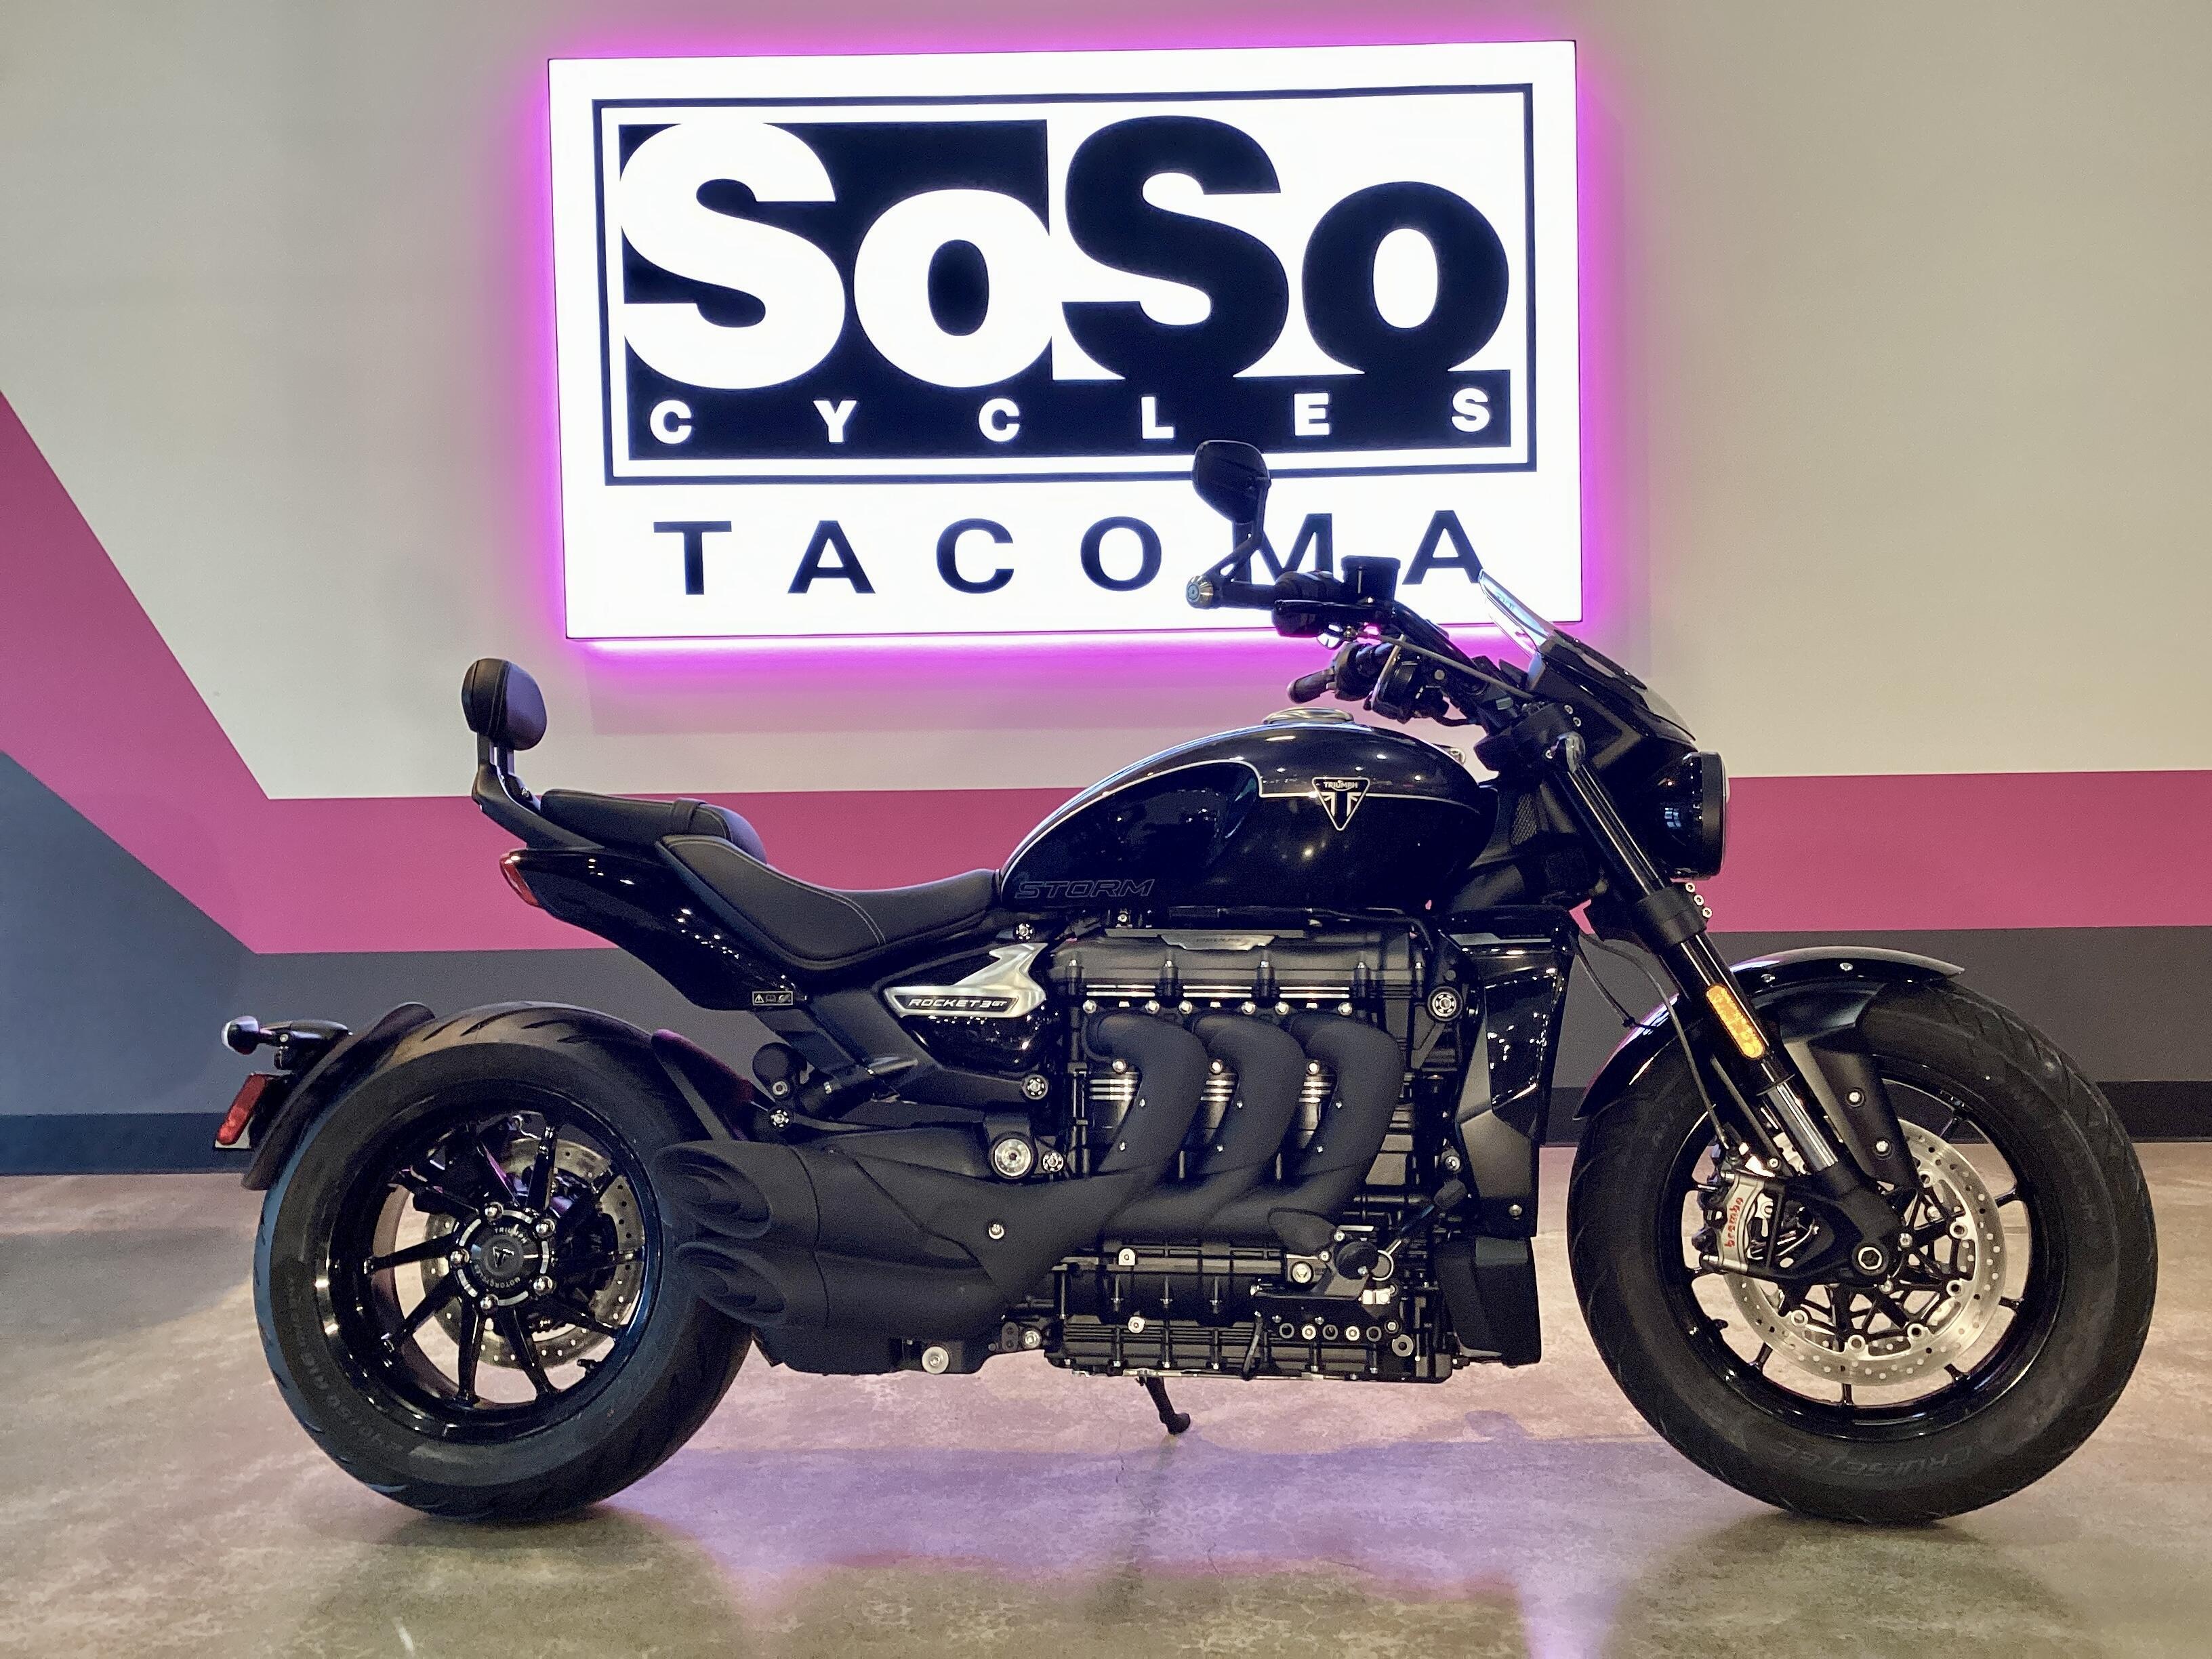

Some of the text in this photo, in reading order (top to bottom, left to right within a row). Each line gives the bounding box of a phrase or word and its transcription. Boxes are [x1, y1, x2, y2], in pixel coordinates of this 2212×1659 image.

[617, 115, 1510, 390] SoSo
[649, 386, 1491, 445] CYCLES
[653, 510, 1486, 594] TACOMA
[1324, 780, 1358, 791] TRIUMPH
[1014, 878, 1155, 899] STORM
[1724, 1197, 1744, 1248] brembo
